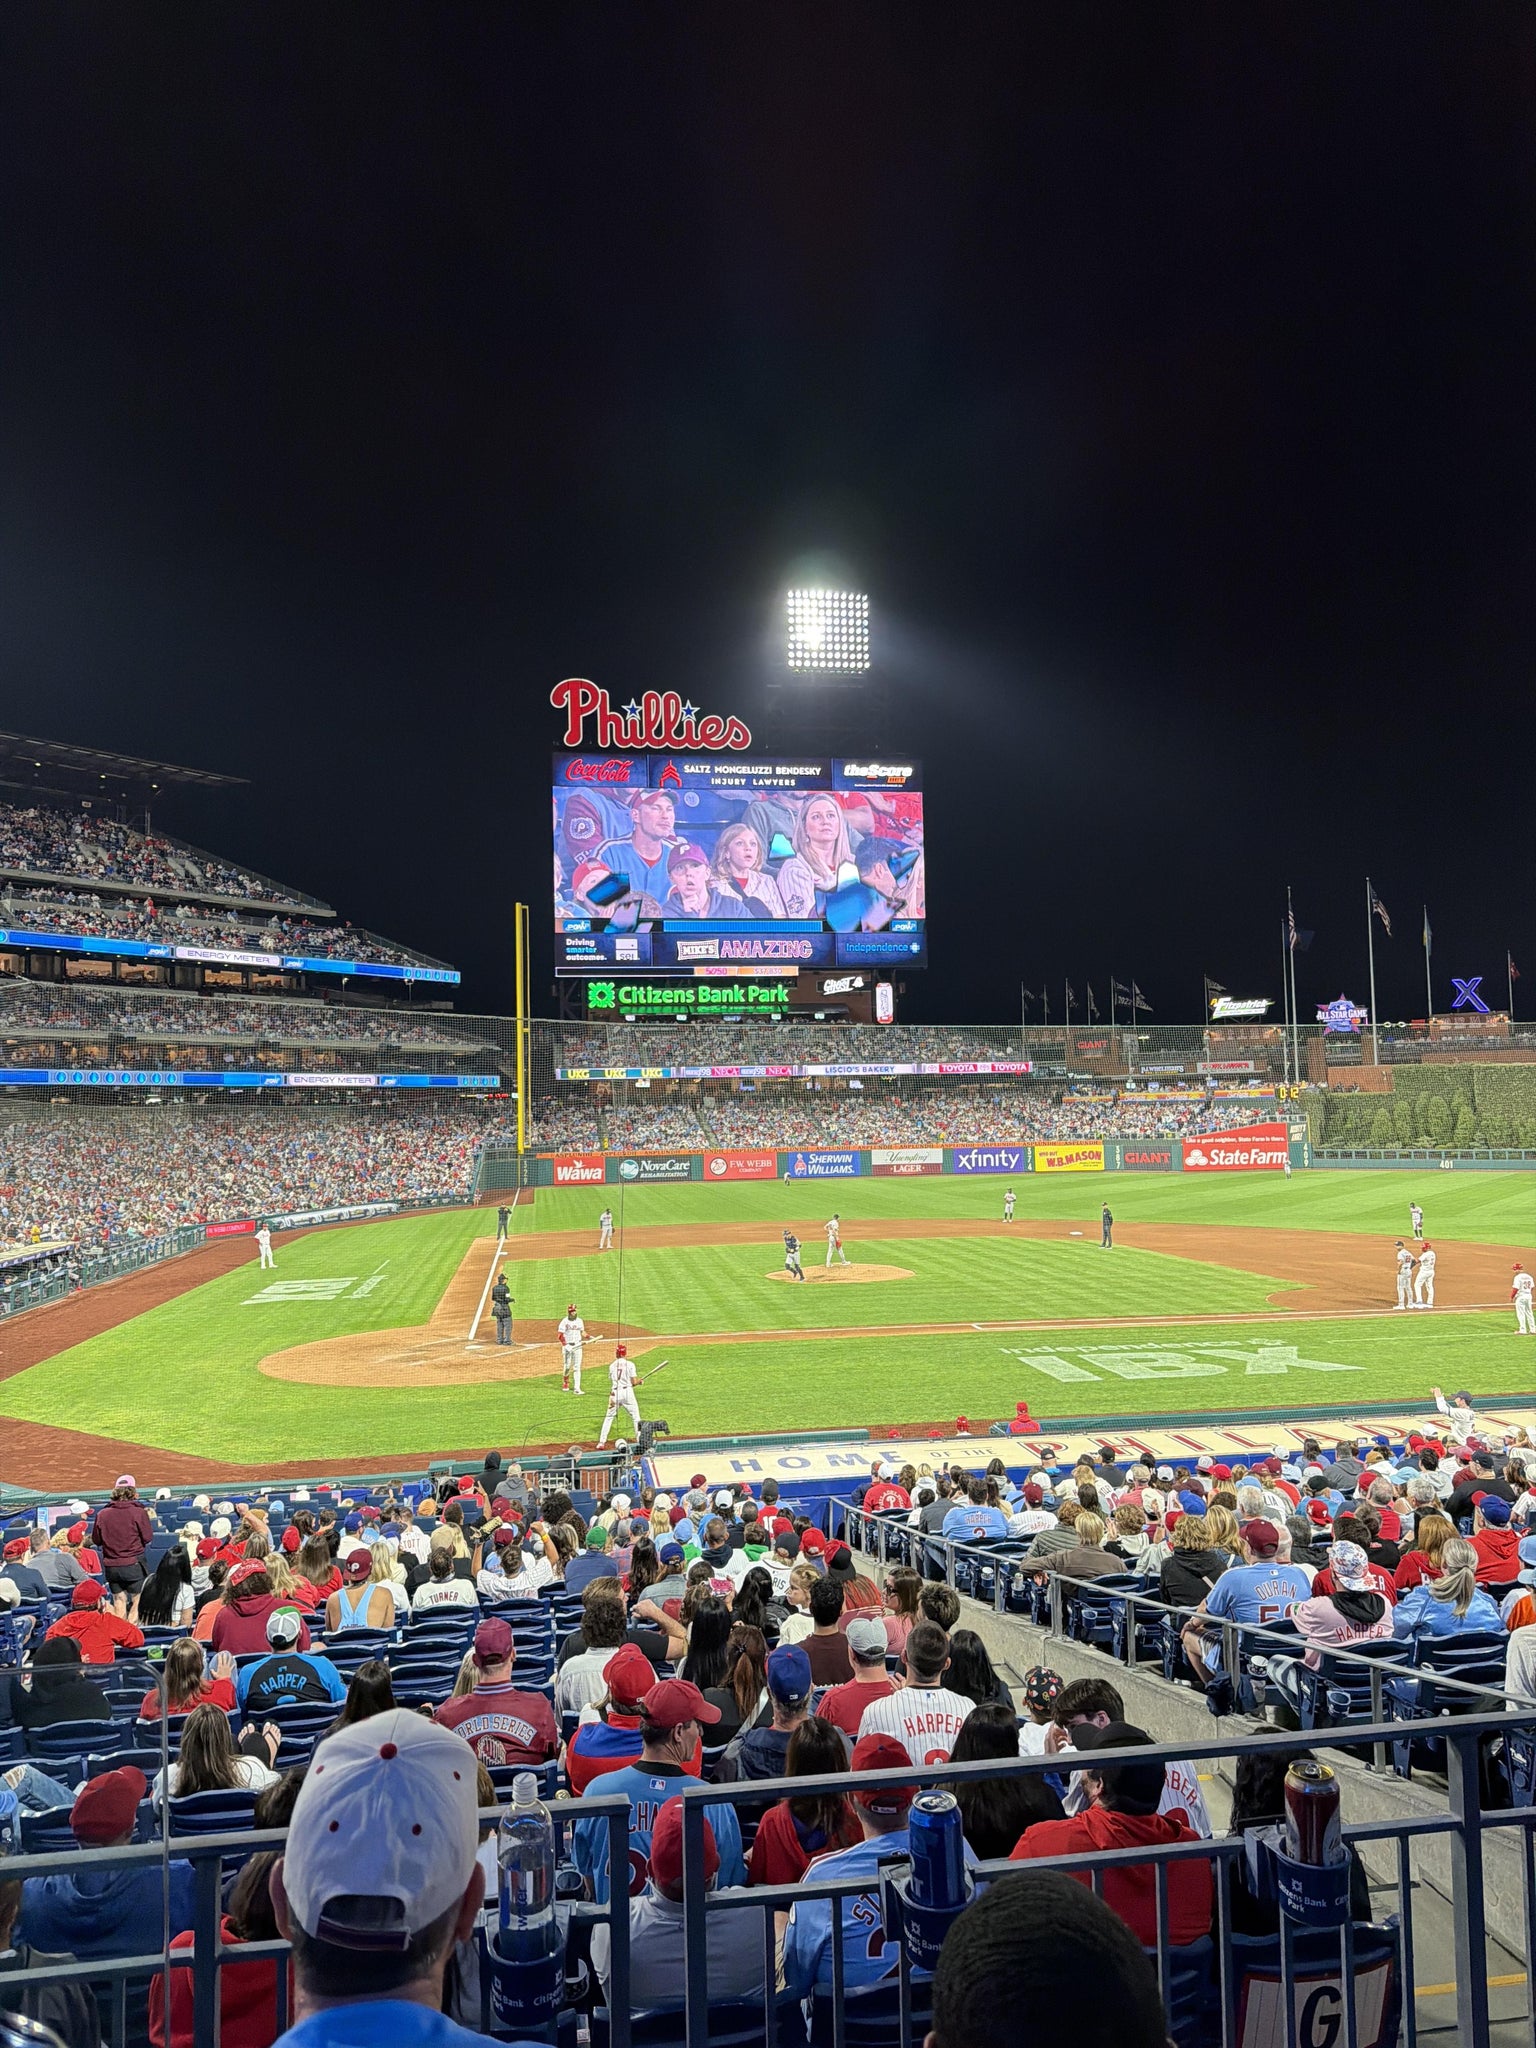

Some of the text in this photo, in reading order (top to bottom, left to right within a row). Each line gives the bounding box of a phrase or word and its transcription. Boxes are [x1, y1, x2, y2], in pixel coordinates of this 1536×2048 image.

[550, 678, 752, 750] Phillies
[565, 759, 634, 782] Coca-Cola
[684, 765, 821, 776] SALTZ MONGELUZZI BENDESKY
[753, 778, 796, 786] LAWYERS
[566, 938, 595, 947] Driving
[846, 942, 909, 954] Independence
[682, 944, 716, 955] MIKE'S
[720, 940, 813, 958] AMAZING
[187, 950, 270, 963] ENERGY METER
[823, 976, 855, 993] GHOST
[618, 984, 789, 1004] Citizens Bank Park
[1216, 997, 1267, 1011] Fitzpatrick
[1316, 1009, 1368, 1020] ALL STAR GAME
[1077, 1040, 1107, 1049] GIANT
[641, 1068, 663, 1078] UKG
[714, 1067, 737, 1076] NECA
[768, 1066, 791, 1075] NECA
[862, 1065, 895, 1073] BAKERY
[941, 1064, 975, 1072] TOYOTA
[994, 1063, 1028, 1071] TOYOTA
[294, 1076, 334, 1084] ENERGY
[567, 1069, 590, 1079] UKG
[604, 1069, 626, 1079] UKG
[808, 1153, 853, 1163] SHERWIN
[886, 1151, 929, 1163] Yuengling
[958, 1149, 1020, 1169] xfinity
[1124, 1152, 1171, 1164] GIANT
[640, 1160, 690, 1171] NovaCare
[746, 1159, 772, 1168] WEBB
[893, 1165, 922, 1173] LAGER
[1440, 1160, 1453, 1169] 401
[557, 1166, 603, 1181] Wawa
[1000, 1340, 1241, 1354] Independence
[1017, 1346, 1368, 1383] IBX
[729, 1450, 908, 1473] HOME
[929, 1450, 943, 1458] OF
[963, 1448, 996, 1457] THE
[965, 1513, 992, 1525] HARPER
[1254, 1579, 1298, 1601] DURAN
[429, 1591, 459, 1605] TURNER
[1335, 1623, 1384, 1641] HARPER
[260, 1673, 308, 1695] HARPER
[454, 1716, 535, 1742] ORLD SERIES
[903, 1713, 963, 1738] HARPER
[1287, 1898, 1305, 1913] Park
[1304, 1896, 1327, 1908] Bank
[503, 1994, 524, 2009] Bank
